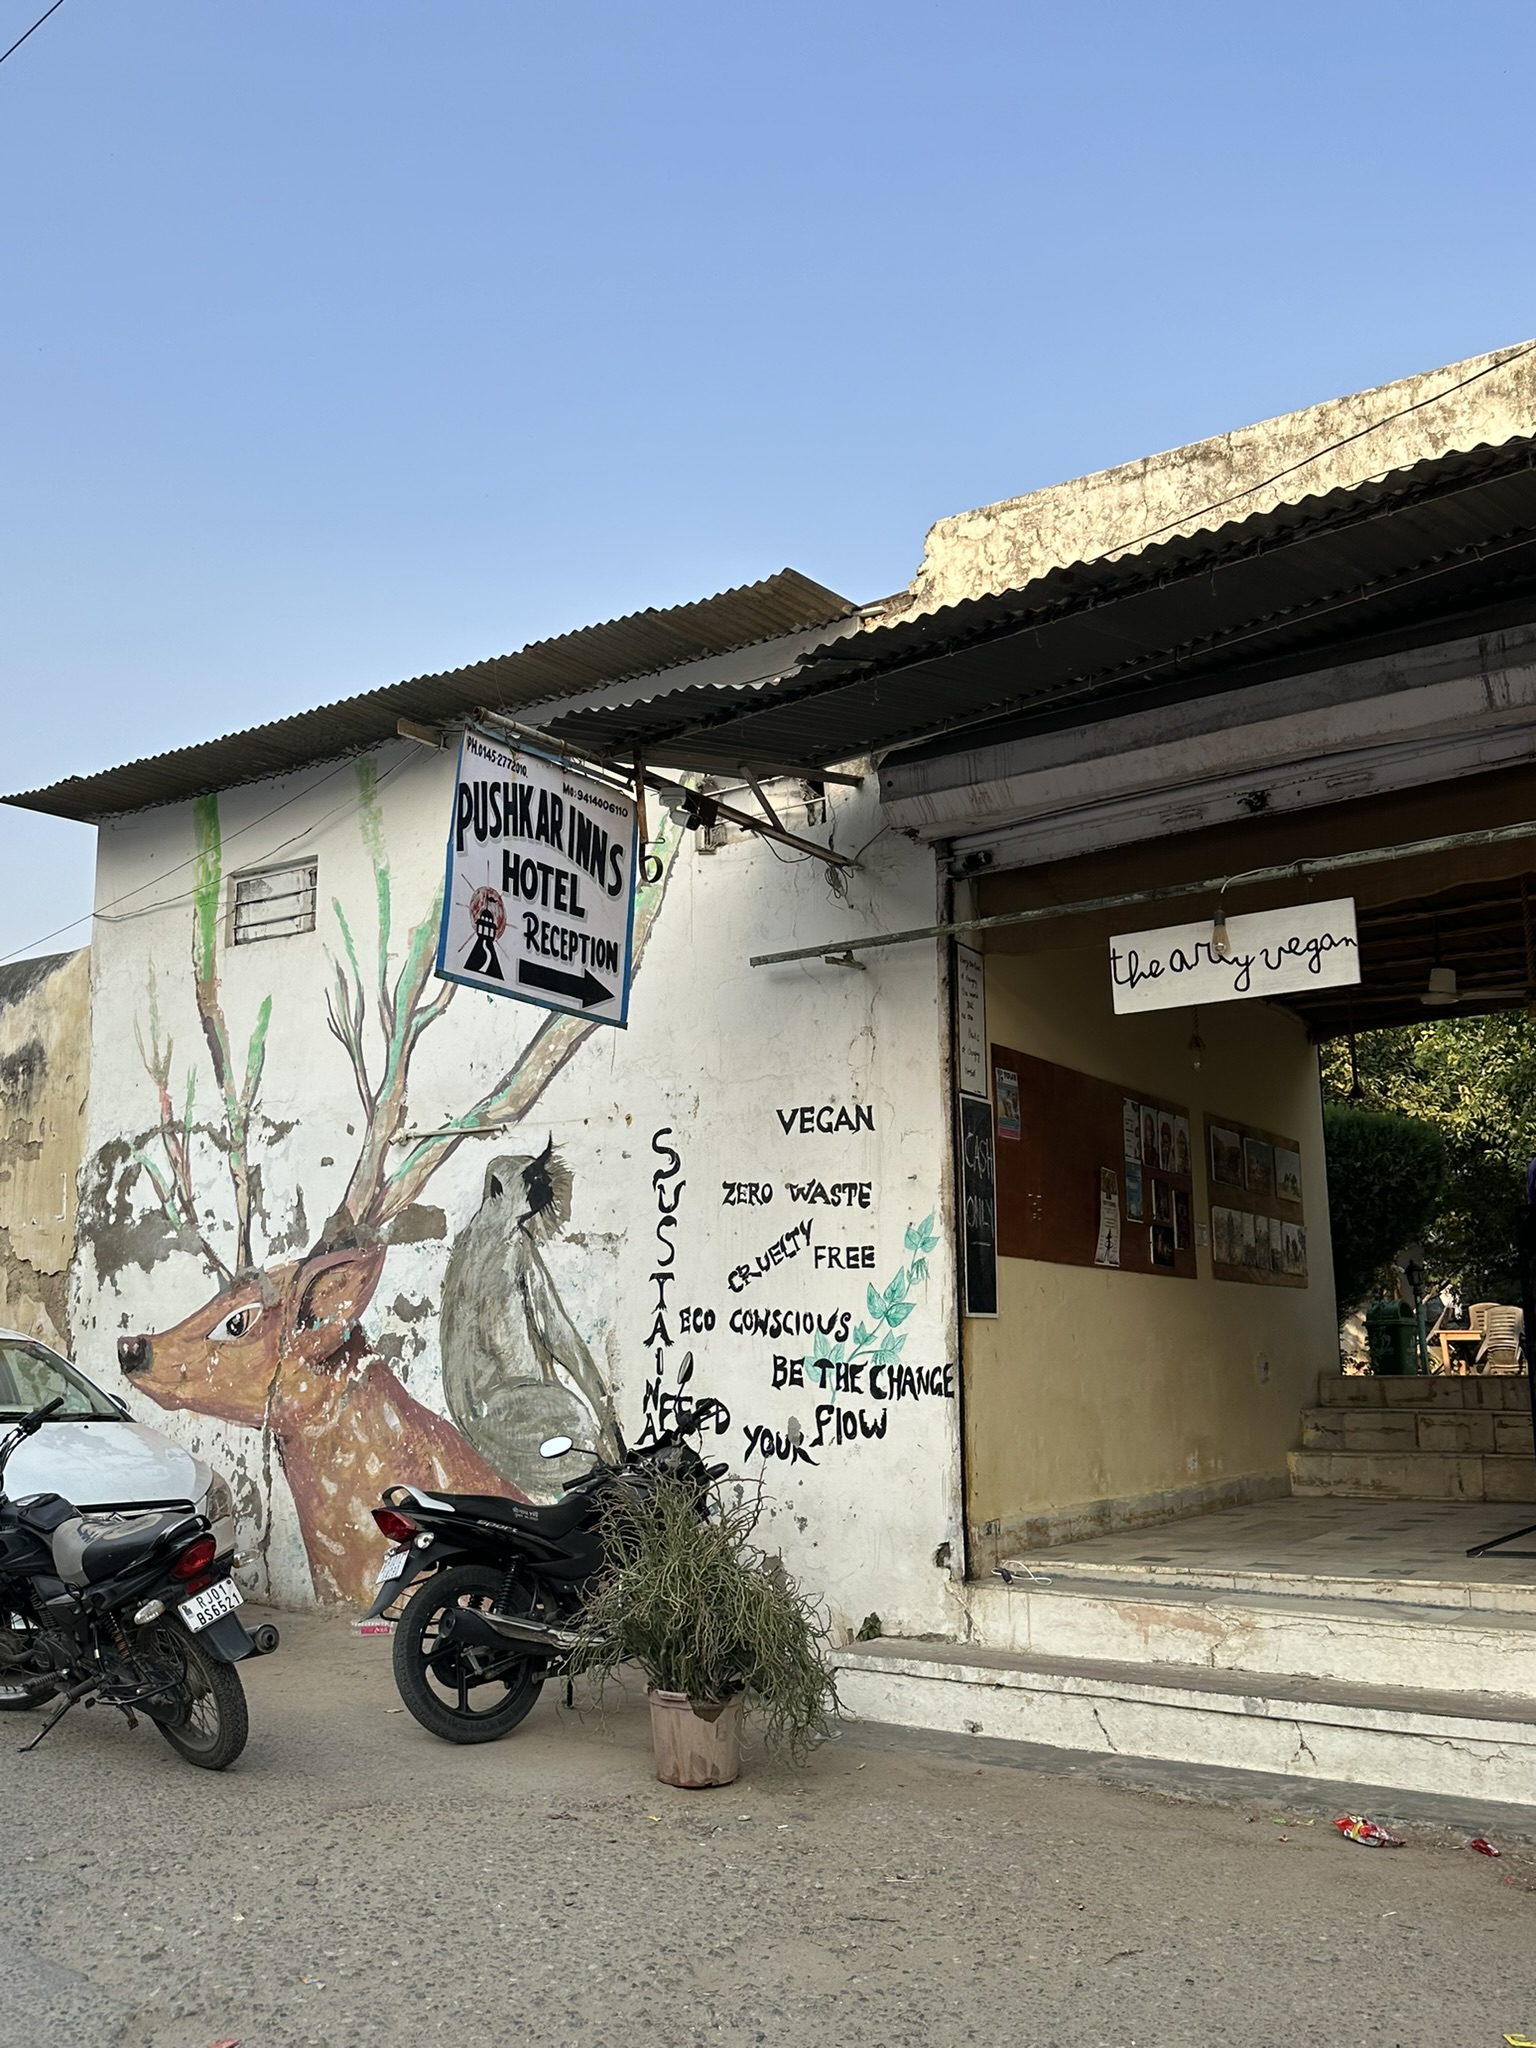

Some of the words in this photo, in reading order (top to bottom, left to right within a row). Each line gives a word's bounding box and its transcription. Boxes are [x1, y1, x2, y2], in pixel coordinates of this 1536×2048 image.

[456, 780, 564, 852] PUSHKAR
[567, 804, 624, 897] INNS
[502, 849, 586, 918] HOTEL
[522, 911, 619, 974] RECEPTION
[1110, 948, 1165, 989] the
[1169, 942, 1256, 992] ary
[1260, 933, 1358, 974] vegan
[776, 1104, 876, 1135] VEGAN
[965, 1131, 994, 1185] CASH
[722, 1180, 773, 1207] ZERO
[789, 1178, 873, 1209] WASTE
[728, 1218, 814, 1293] CRUELTY
[814, 1245, 876, 1270] FREE
[679, 1306, 716, 1334] ECO
[729, 1307, 852, 1342] CONSCIOUS
[771, 1353, 805, 1391] BE
[813, 1357, 869, 1395] THE
[869, 1363, 956, 1401] CHANGE
[743, 1415, 820, 1466] YOUR
[195, 1592, 240, 1626] BS6521
